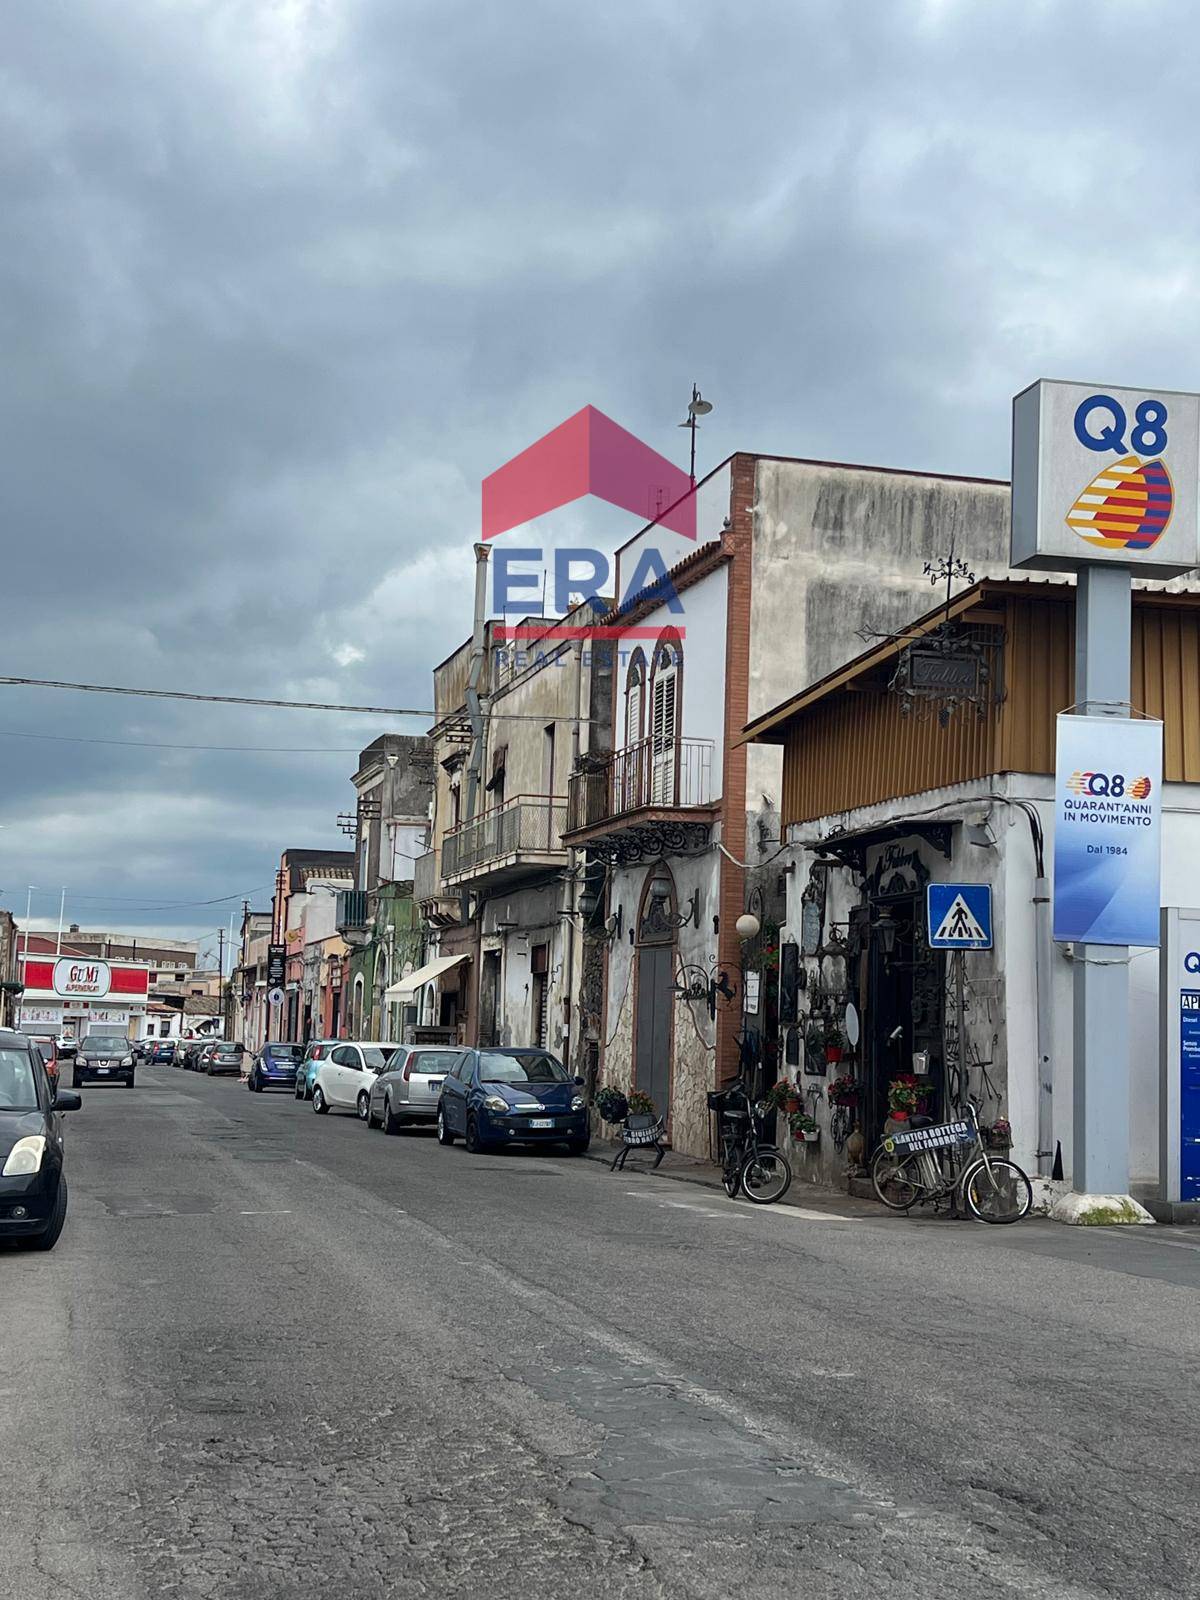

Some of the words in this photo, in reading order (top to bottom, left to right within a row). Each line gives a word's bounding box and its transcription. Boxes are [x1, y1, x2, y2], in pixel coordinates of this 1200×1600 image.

[1074, 394, 1168, 456] Q8
[1088, 773, 1125, 798] Q8
[1064, 799, 1152, 814] QUARANT'ANNI
[1064, 812, 1076, 821] IN
[1080, 812, 1152, 826] MOVIMENTO
[1087, 844, 1103, 854] Dal
[1106, 846, 1128, 855] 1984
[1184, 951, 1200, 974] Q
[1182, 995, 1200, 1009] AP
[928, 1122, 968, 1138] BOTTEGA
[908, 1140, 925, 1152] DEL
[924, 1134, 956, 1150] FABBRO
